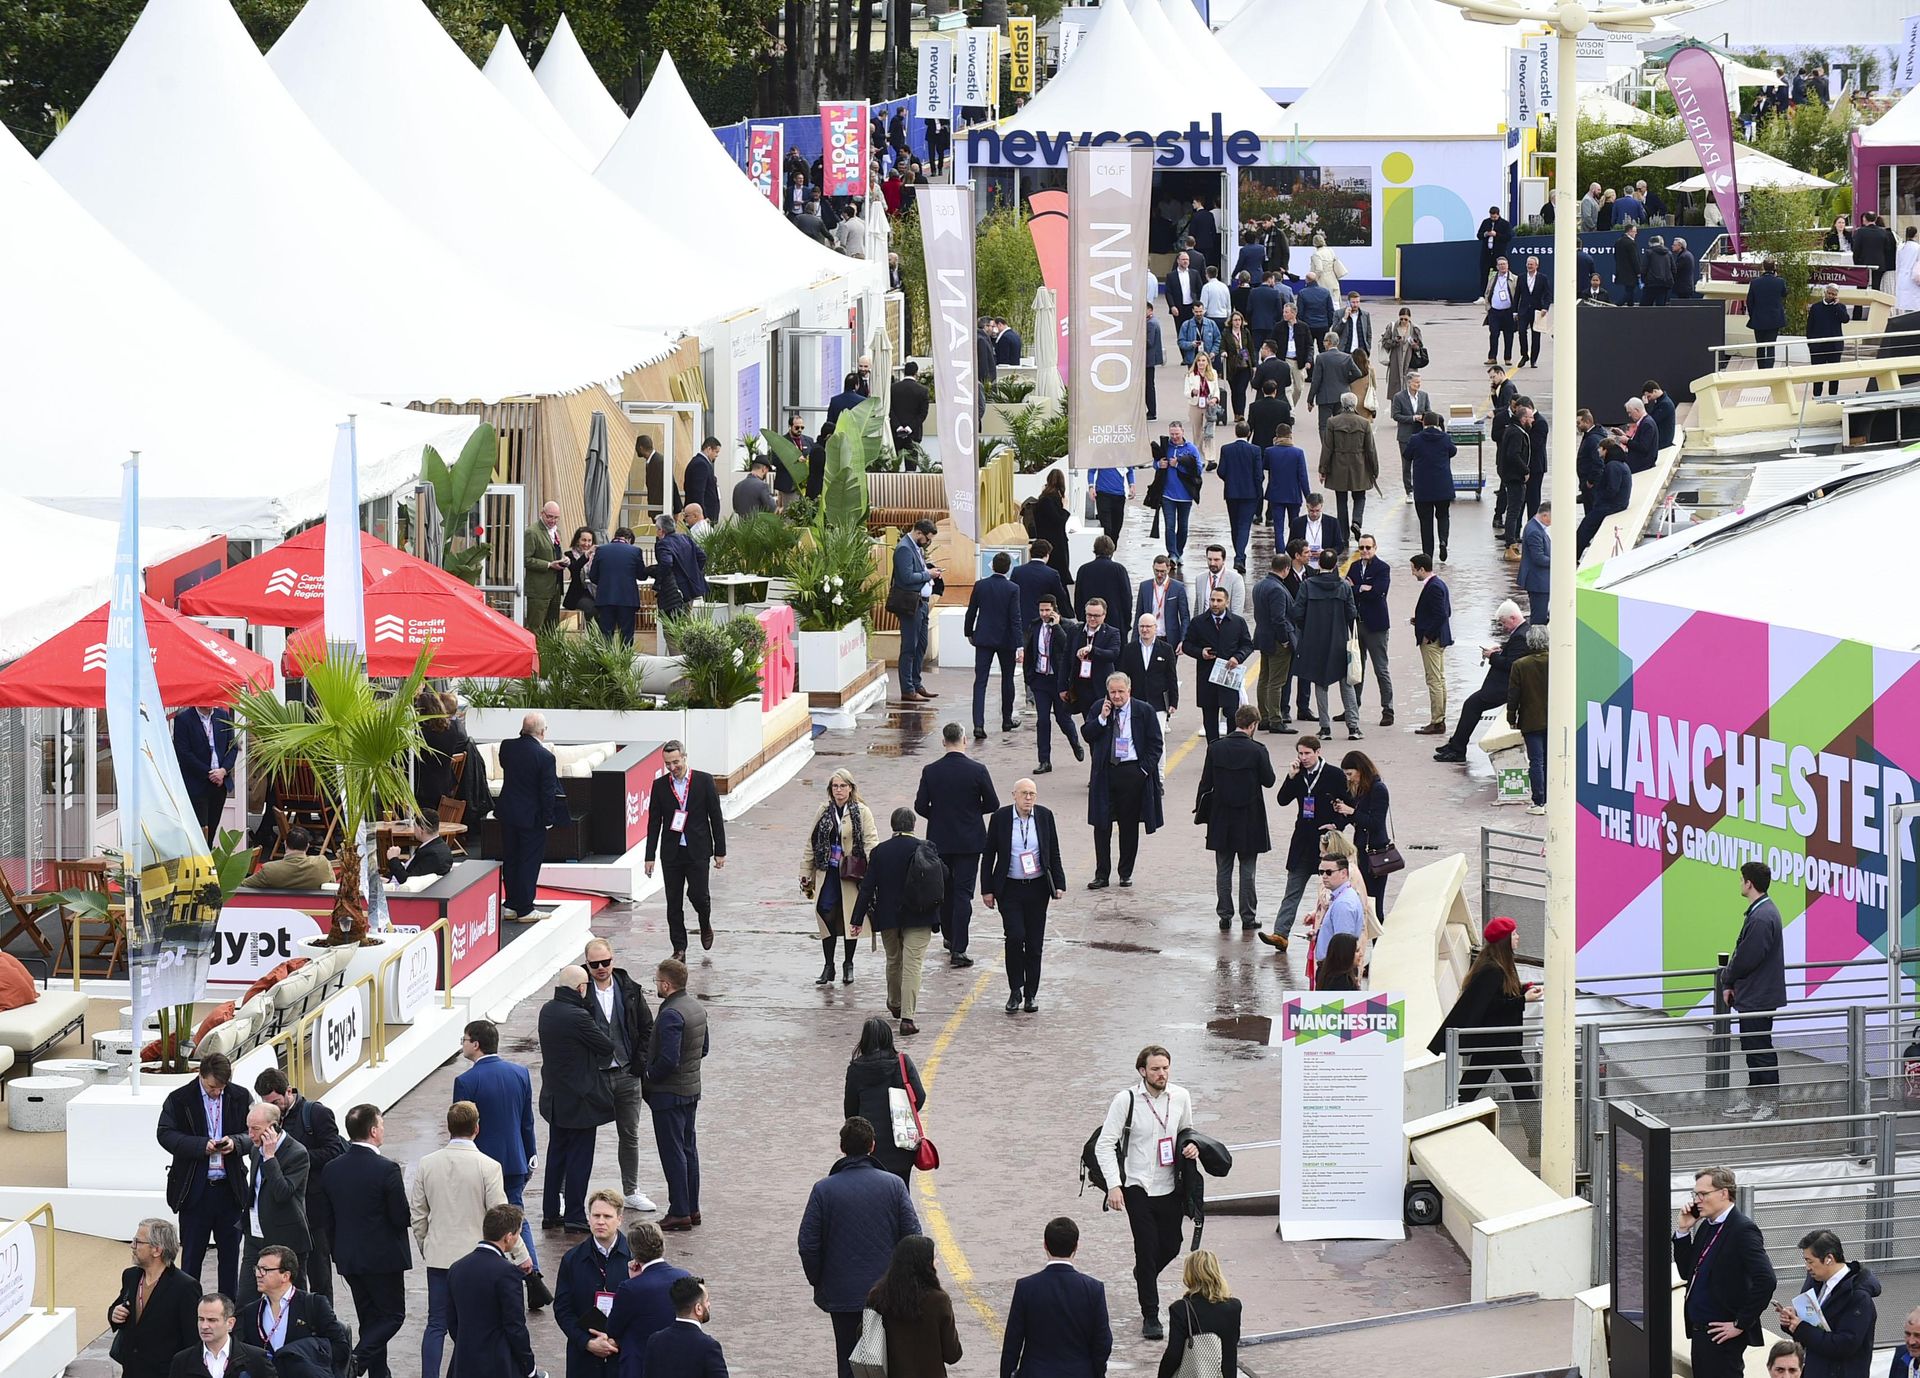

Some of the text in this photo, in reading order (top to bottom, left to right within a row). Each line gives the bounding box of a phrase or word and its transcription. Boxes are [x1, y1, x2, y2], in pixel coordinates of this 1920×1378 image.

[966, 36, 979, 101] newcastle
[1014, 25, 1029, 89] Belfast
[1539, 42, 1552, 108] newcastle
[928, 46, 941, 112] newcastle
[1518, 55, 1530, 122] newcastle
[830, 121, 846, 174] POOL
[844, 116, 859, 179] LIVER
[1267, 123, 1317, 166] uk
[1097, 164, 1127, 176] C16.F
[1740, 270, 1761, 278] PATRI
[1813, 271, 1847, 281] PATRIZIA
[1090, 222, 1133, 393] OMAN
[1088, 434, 1136, 445] HORIZONS
[1092, 424, 1132, 434] ENDLESS
[408, 618, 446, 627] Cardiff
[408, 626, 446, 636] Capital
[408, 635, 444, 645] Regon
[1586, 700, 1916, 862] MANCHESTER
[1598, 804, 1889, 910] THE UK'S GROWTH OPPORTUNIT
[210, 927, 291, 966] gypt
[250, 931, 259, 967] OPPORTUNITY
[1290, 1013, 1398, 1031] MANCHESTER
